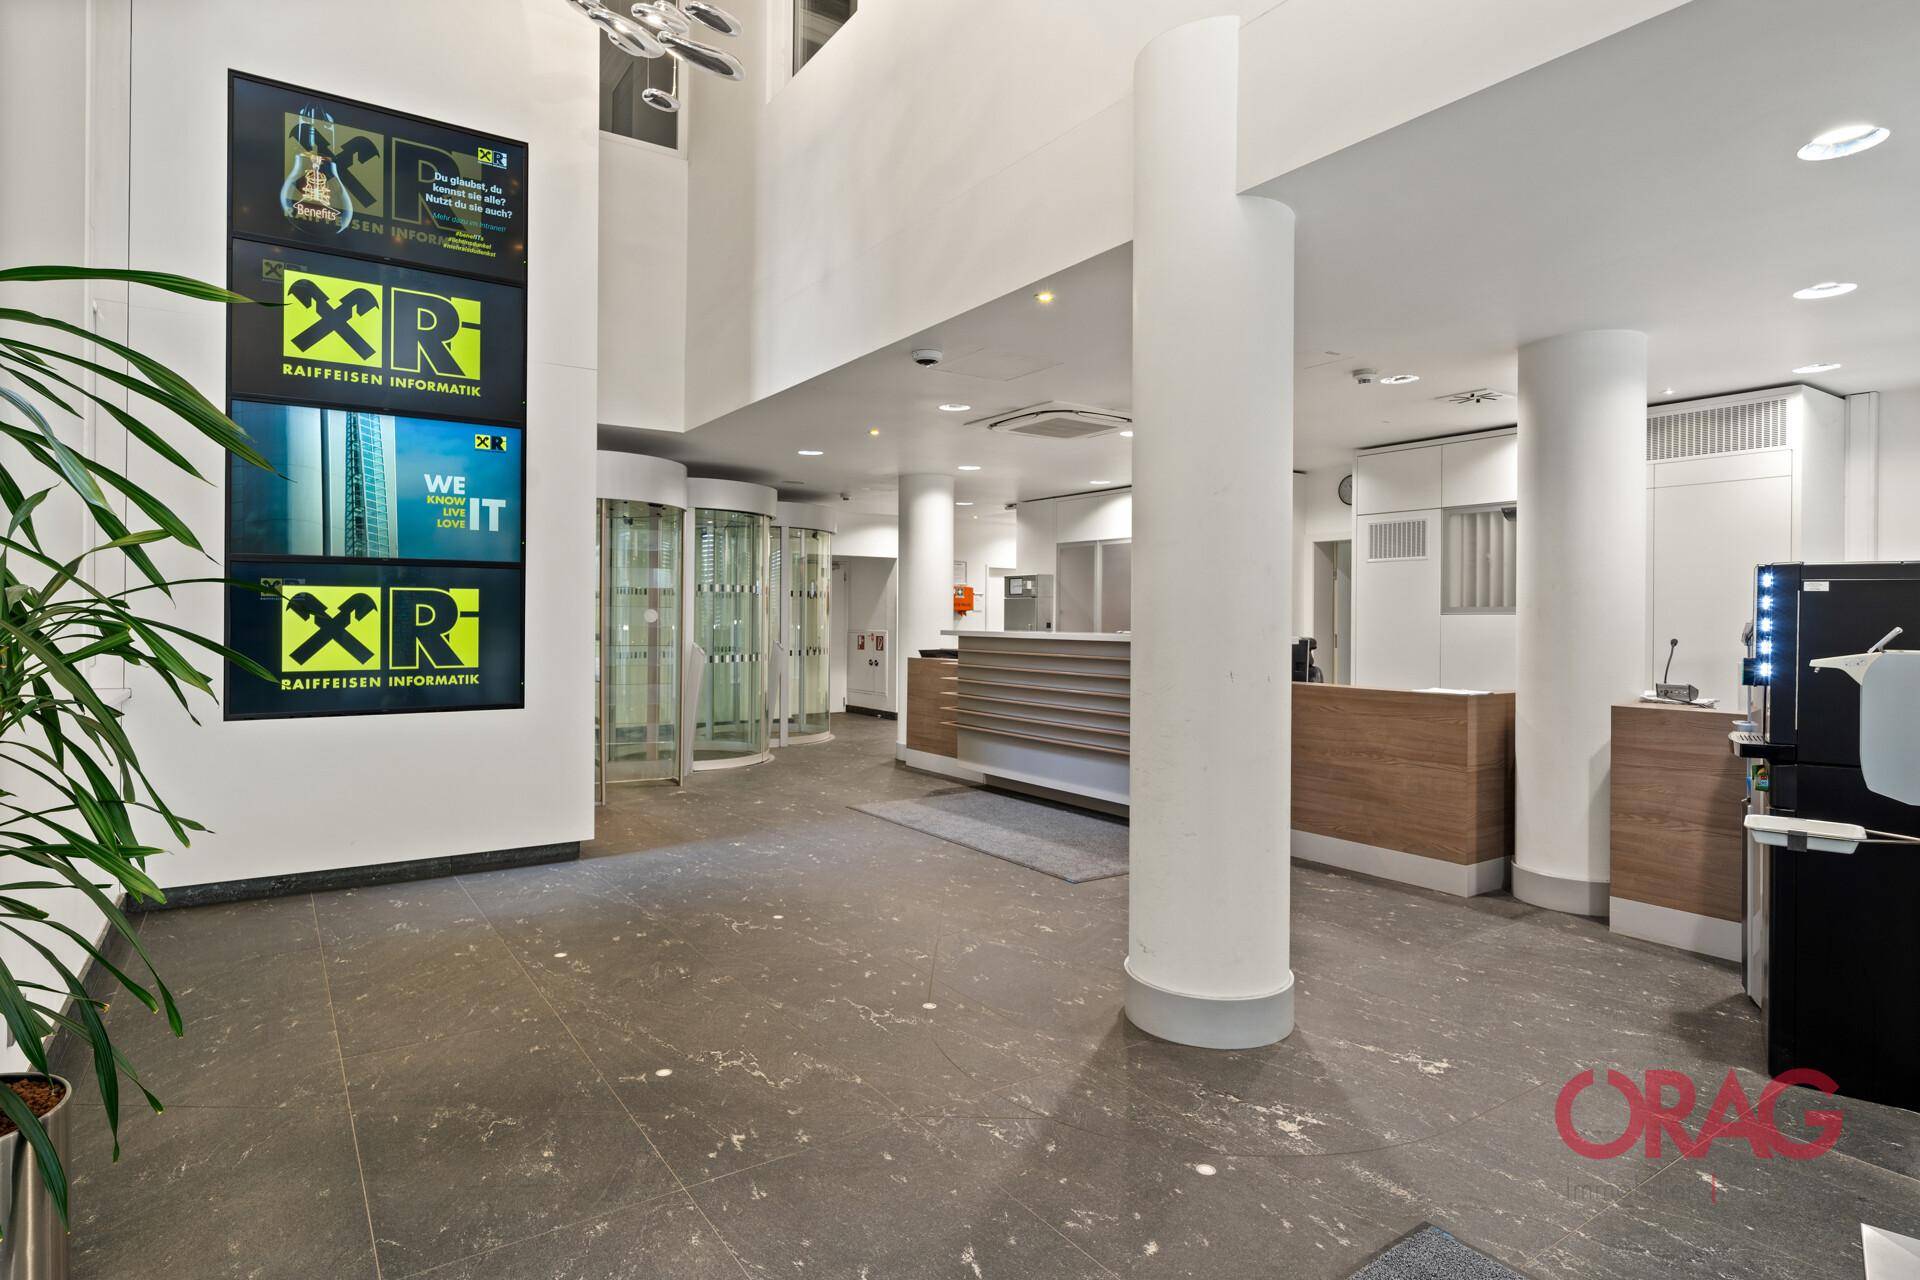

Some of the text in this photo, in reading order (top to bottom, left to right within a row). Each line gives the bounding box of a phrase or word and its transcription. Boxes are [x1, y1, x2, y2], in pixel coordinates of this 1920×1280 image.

[434, 171, 502, 194] Du glaubst, du
[432, 183, 506, 206] kennst sie alle?
[297, 204, 337, 220] Benefits
[425, 193, 513, 219] Nutzt du sie auch?
[283, 363, 481, 397] RAIFFEISEN INFORMATIK
[424, 474, 465, 495] WE
[426, 496, 466, 506] KNOW
[443, 508, 466, 517] LIVE
[469, 497, 506, 532] IT
[437, 519, 466, 529] LOVE
[281, 674, 479, 691] RAIFFEISEN INFORMATIK
